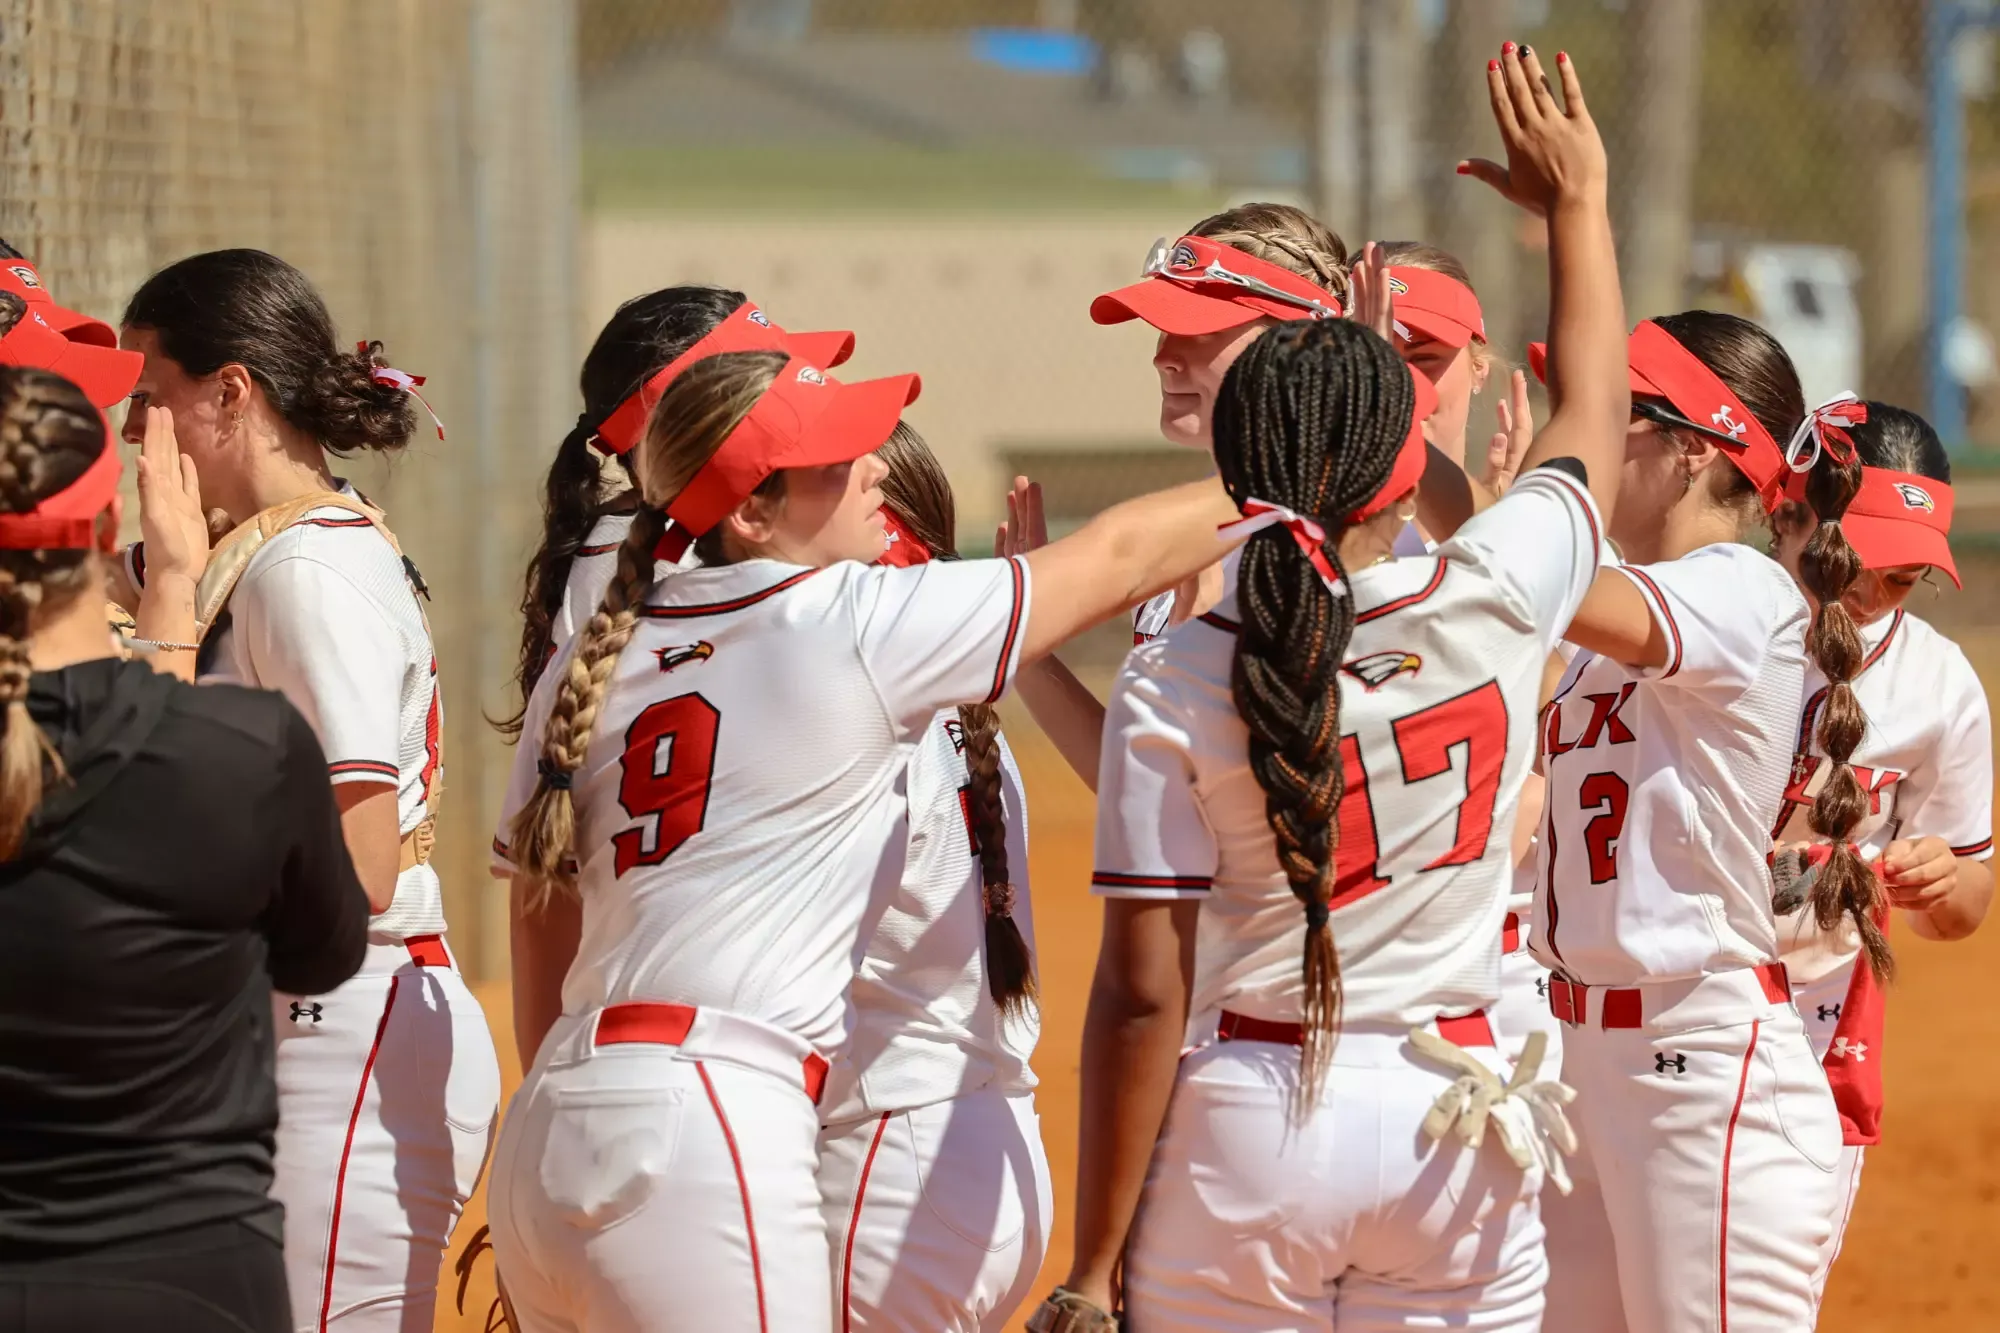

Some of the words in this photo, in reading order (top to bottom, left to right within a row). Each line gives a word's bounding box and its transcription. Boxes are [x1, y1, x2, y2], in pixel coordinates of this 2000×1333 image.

[611, 691, 721, 880] 9
[1328, 678, 1509, 913] 17
[1580, 771, 1630, 885] 2
